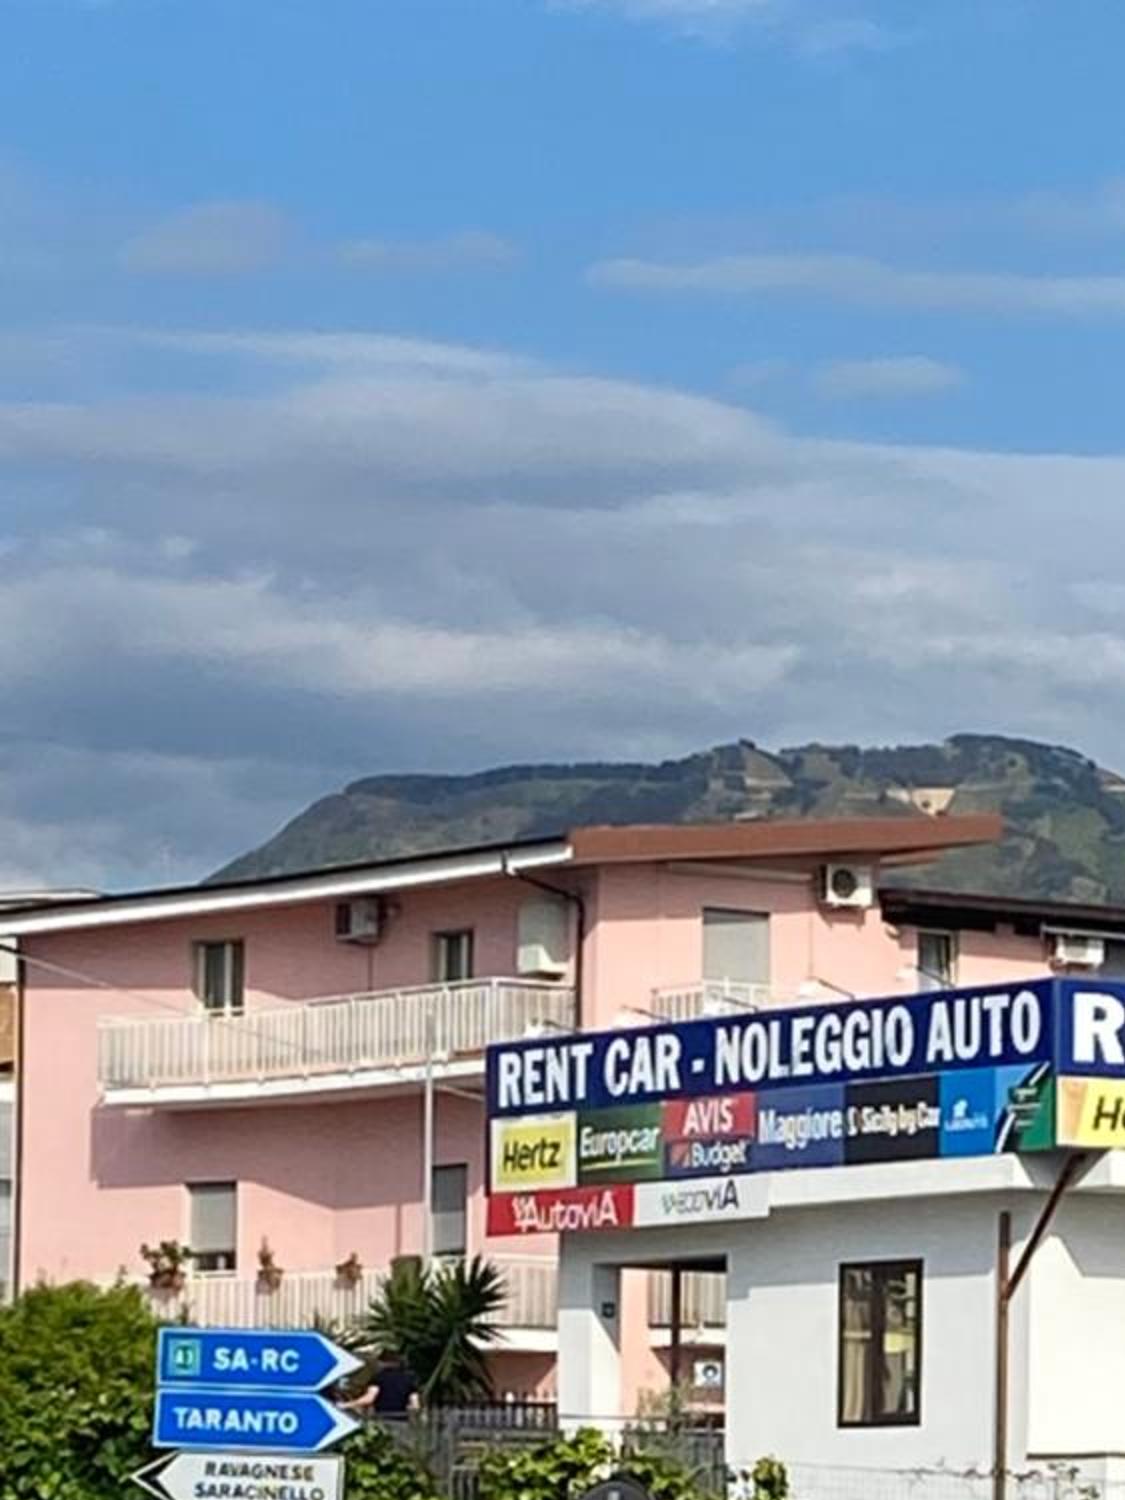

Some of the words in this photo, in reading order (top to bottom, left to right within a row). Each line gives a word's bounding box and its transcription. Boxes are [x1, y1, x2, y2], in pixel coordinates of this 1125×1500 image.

[499, 1042, 593, 1108] RENT
[604, 1033, 680, 1097] CAR
[715, 1005, 913, 1085] NOLEGGIO
[926, 991, 1041, 1063] AUTO
[682, 1098, 733, 1137] AVIS
[758, 1107, 843, 1150] Maggiore
[503, 1137, 561, 1172] Hertz
[580, 1124, 661, 1164] Europcar
[691, 1140, 748, 1172] Budget
[173, 1407, 298, 1434] TARANTO
[204, 1461, 315, 1481] RAVAGNESE
